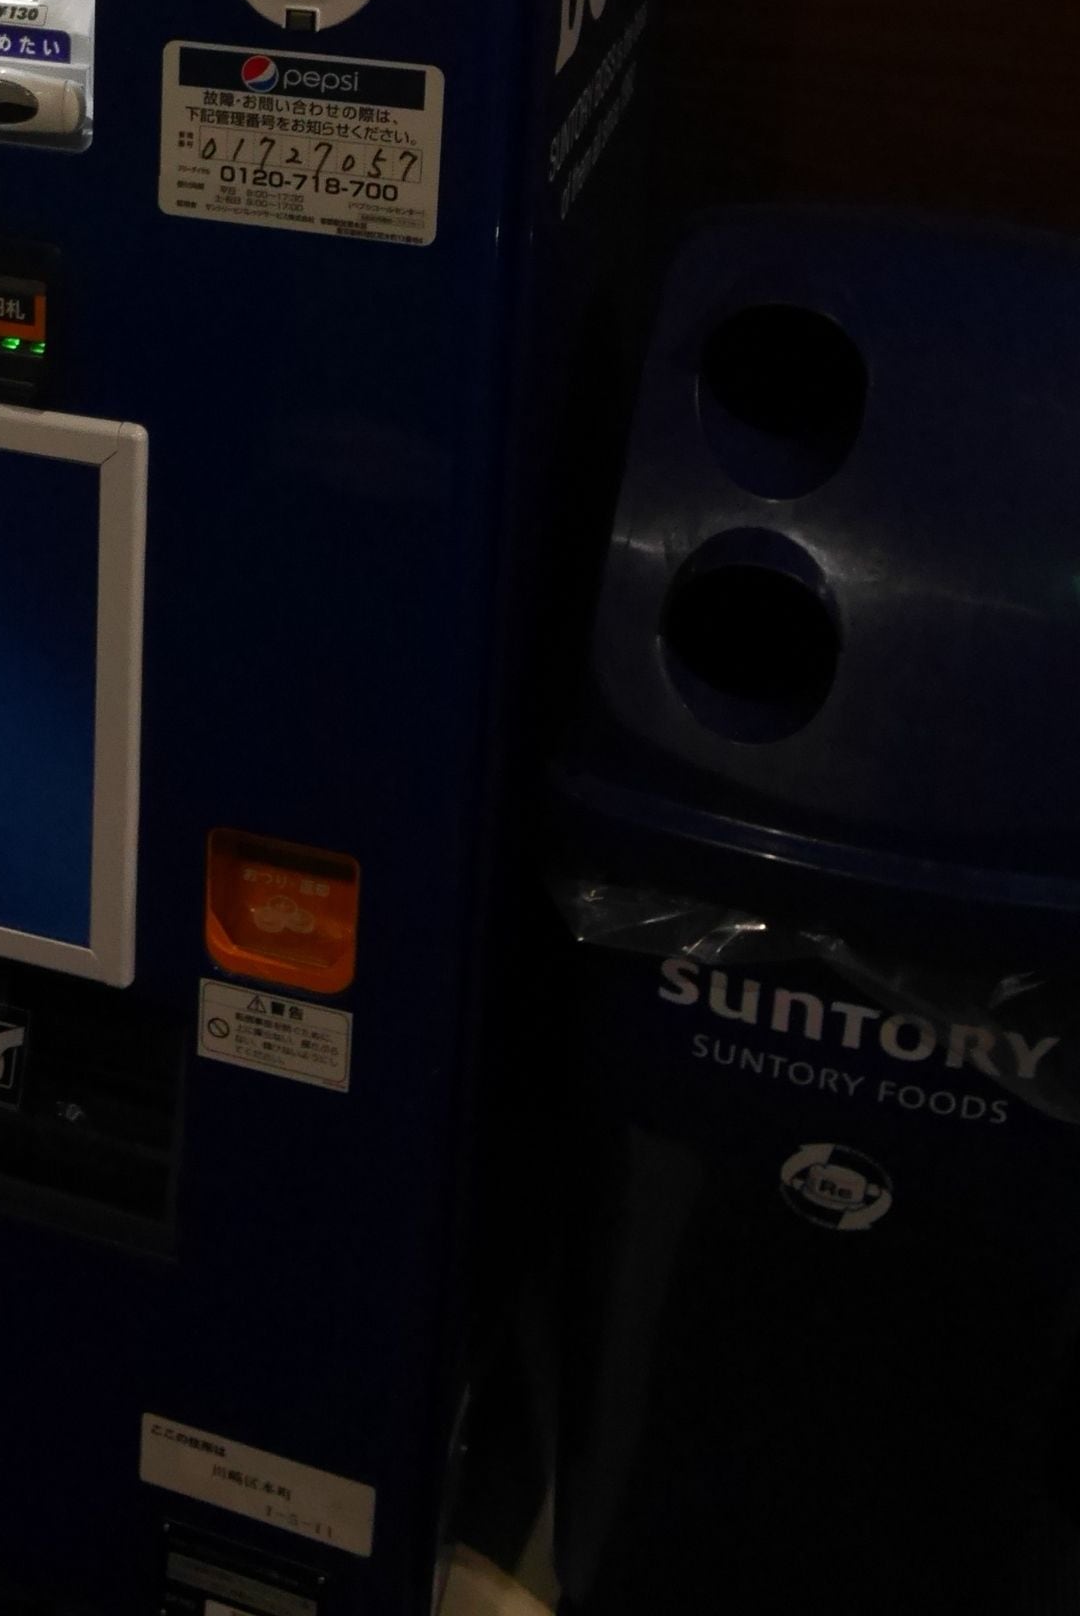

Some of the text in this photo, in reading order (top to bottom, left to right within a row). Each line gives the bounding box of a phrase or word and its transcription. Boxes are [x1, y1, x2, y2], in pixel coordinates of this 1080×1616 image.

[282, 68, 360, 94] pepsi
[185, 105, 418, 146] 下記管理番号をお知らせください。
[220, 164, 399, 203] 0120-718-700
[658, 957, 1060, 1080] SUNTORY
[691, 1033, 1009, 1125] SUNTORY FOODS
